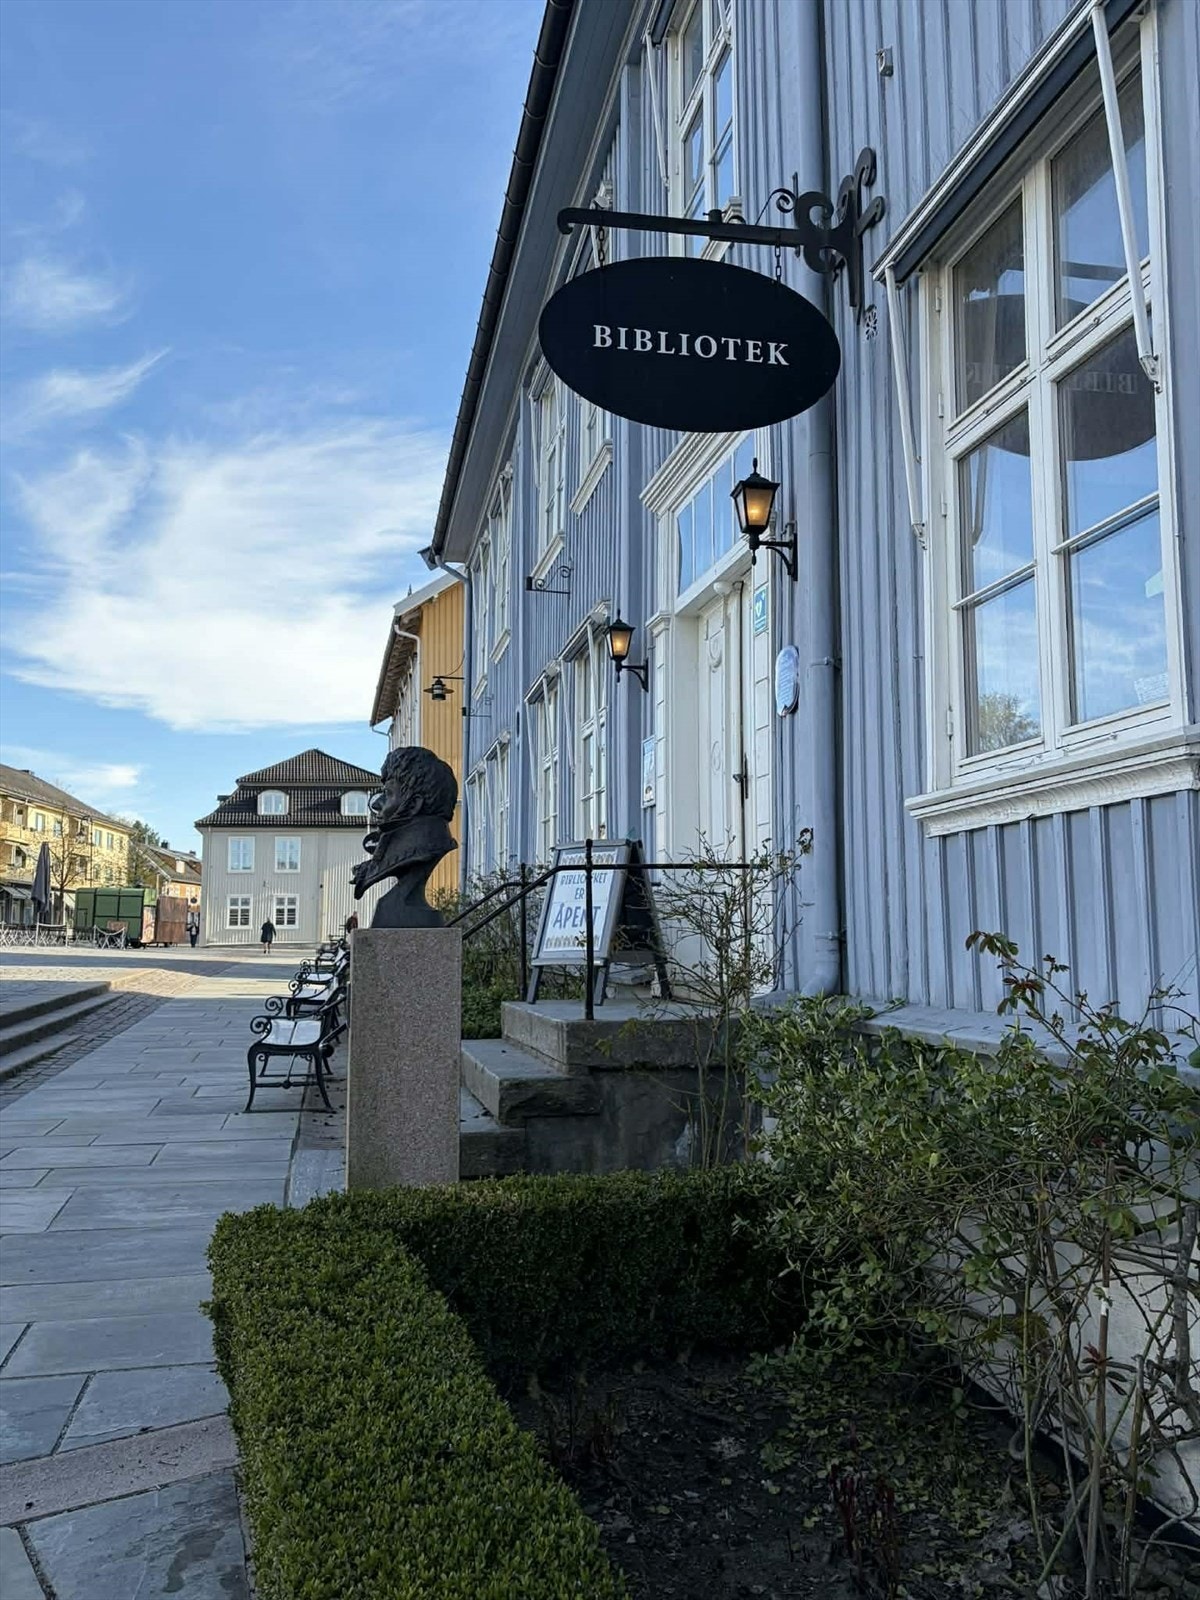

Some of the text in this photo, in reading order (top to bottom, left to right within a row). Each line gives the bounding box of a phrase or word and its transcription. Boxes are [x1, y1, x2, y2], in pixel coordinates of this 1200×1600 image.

[593, 324, 789, 366] BIBLIOTEK
[560, 872, 608, 885] BIBLIOKET
[575, 887, 585, 900] ER
